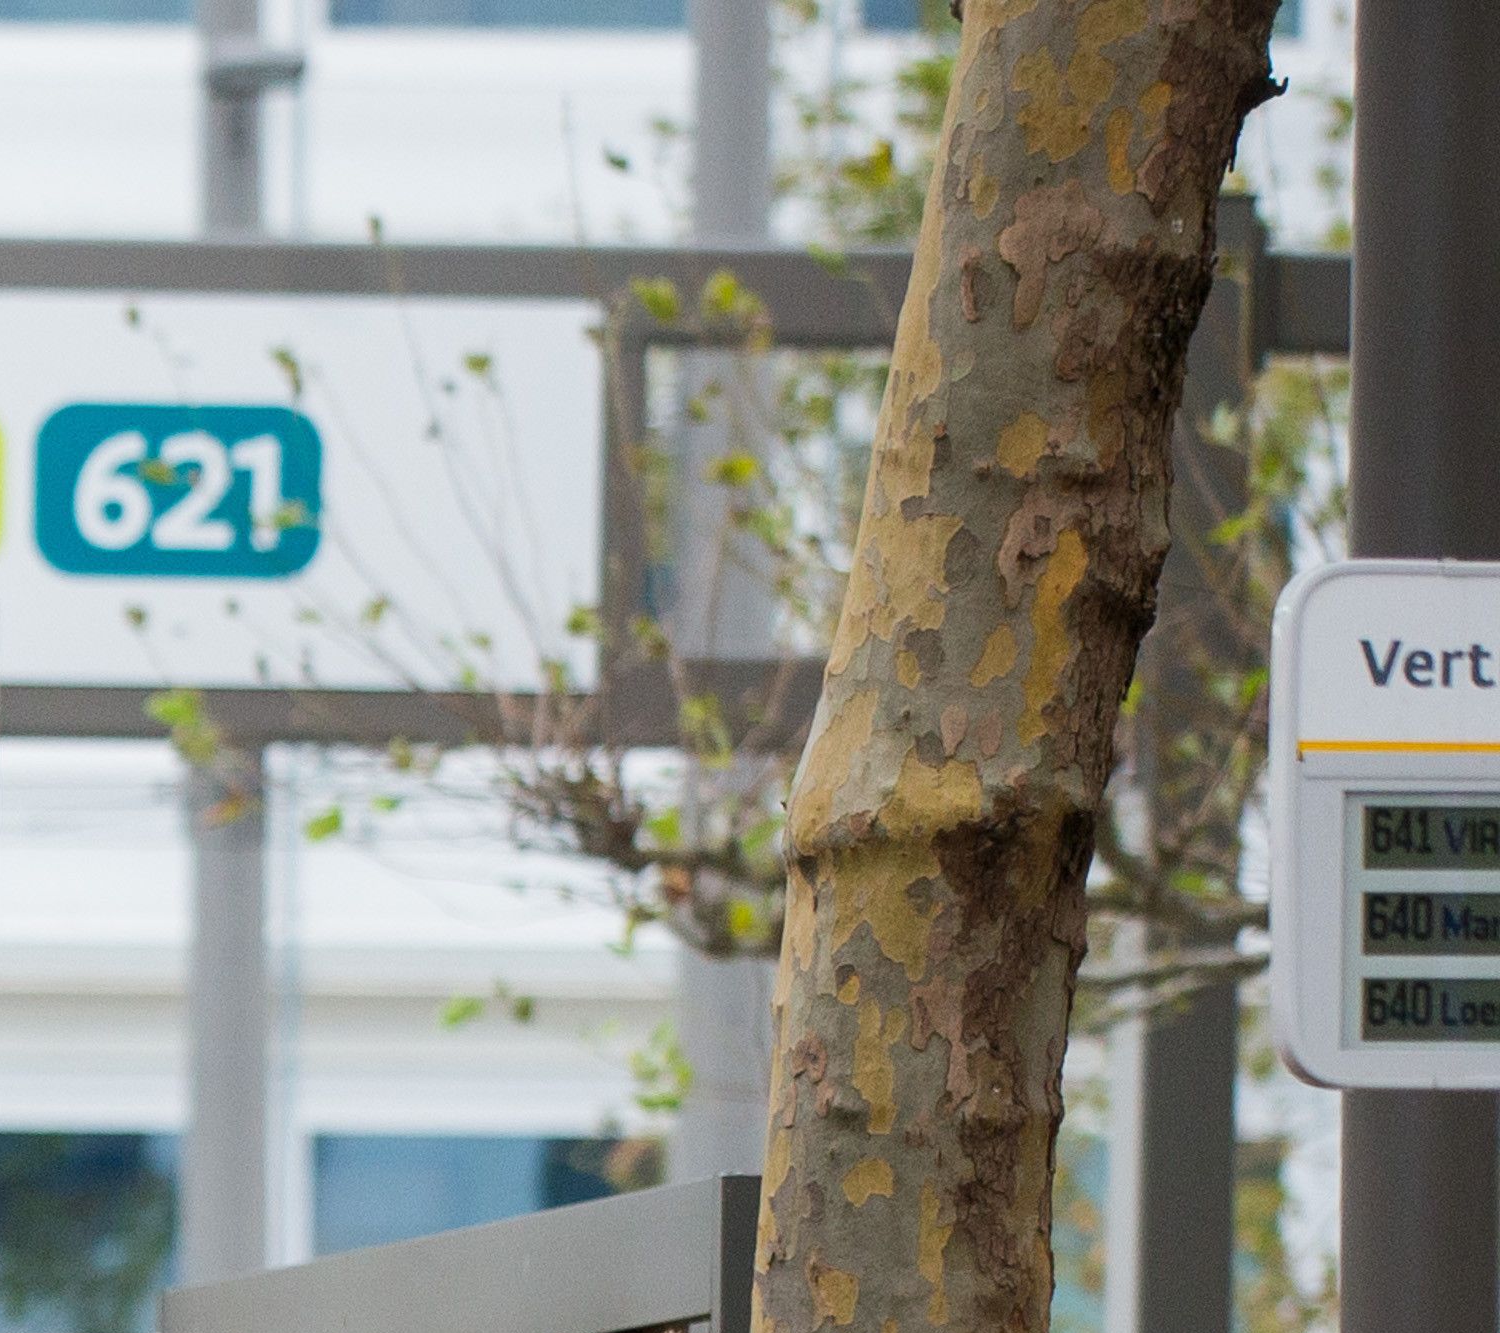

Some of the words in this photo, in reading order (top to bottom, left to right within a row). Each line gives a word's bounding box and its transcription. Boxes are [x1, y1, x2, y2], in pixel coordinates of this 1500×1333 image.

[72, 428, 287, 553] 621
[1371, 807, 1432, 855] 641
[1368, 894, 1433, 942] 640
[1367, 980, 1432, 1028] 640
